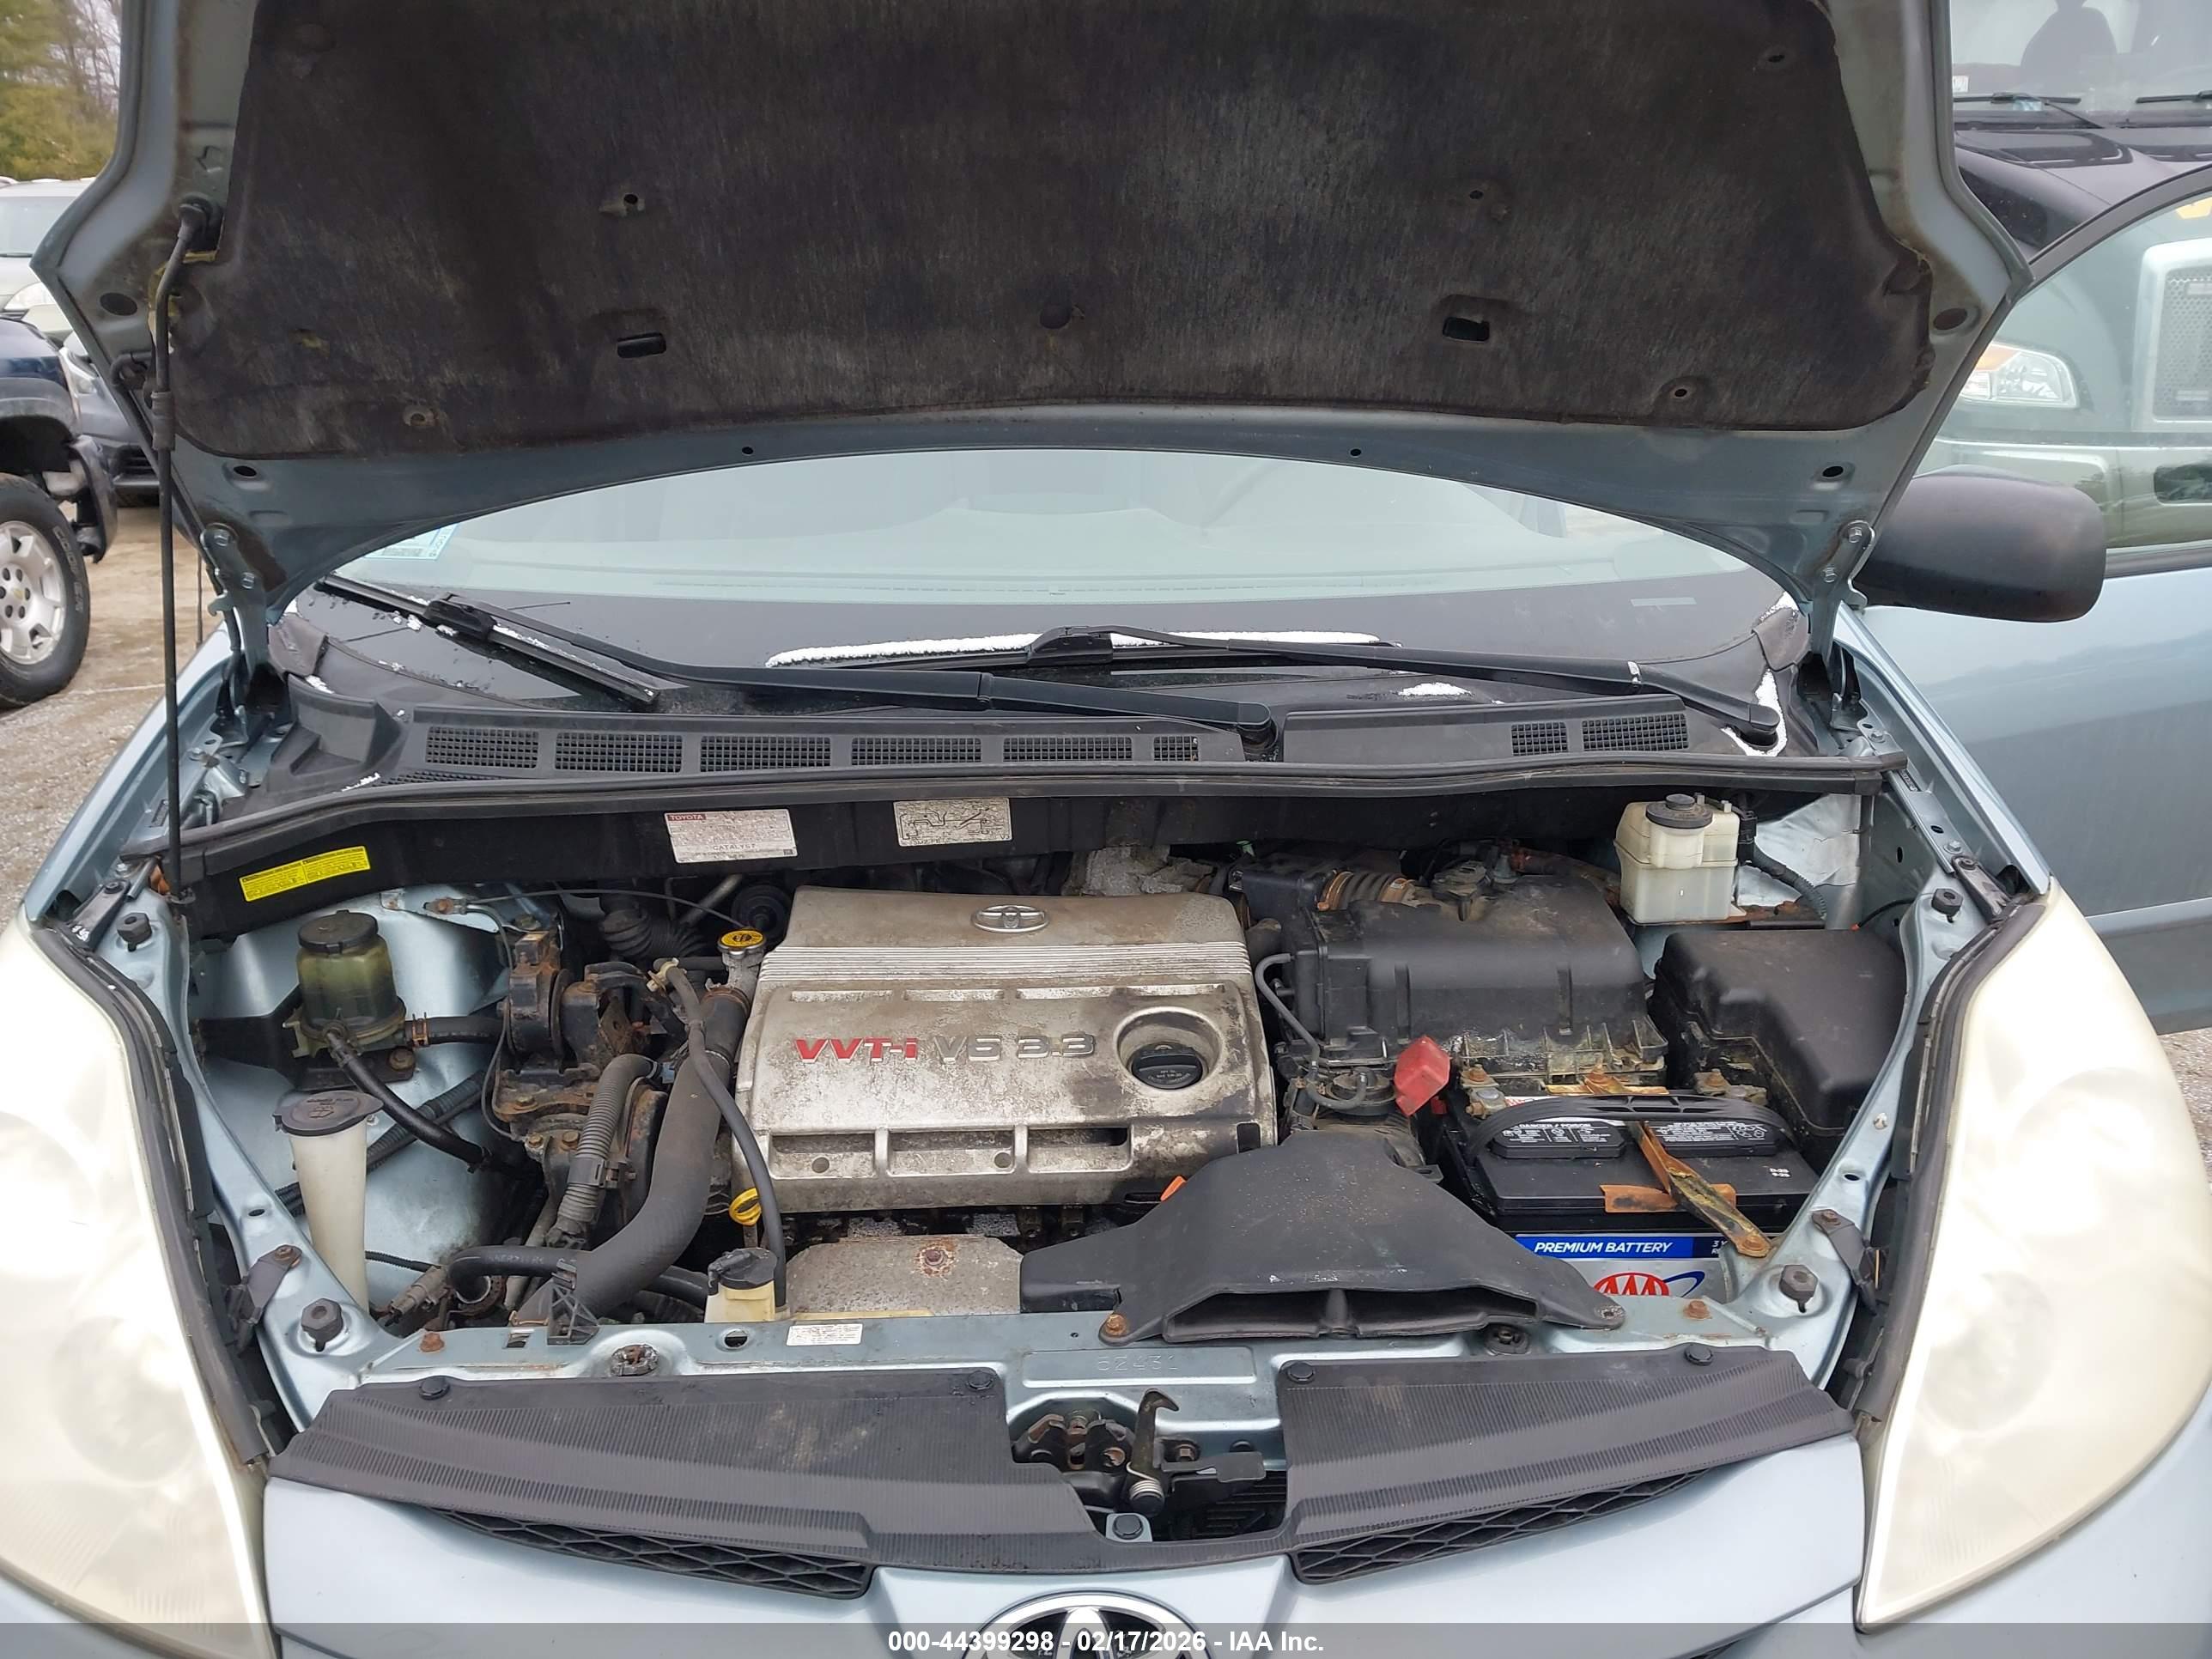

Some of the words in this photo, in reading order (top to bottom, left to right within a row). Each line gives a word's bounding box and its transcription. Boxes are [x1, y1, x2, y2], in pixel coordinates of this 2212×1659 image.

[793, 1036, 919, 1063] VVT-i
[933, 1035, 1001, 1065] V6
[1017, 1032, 1096, 1059] 3.3
[1534, 1242, 1603, 1253] PREMIUM
[1605, 1242, 1674, 1253] BATTERY
